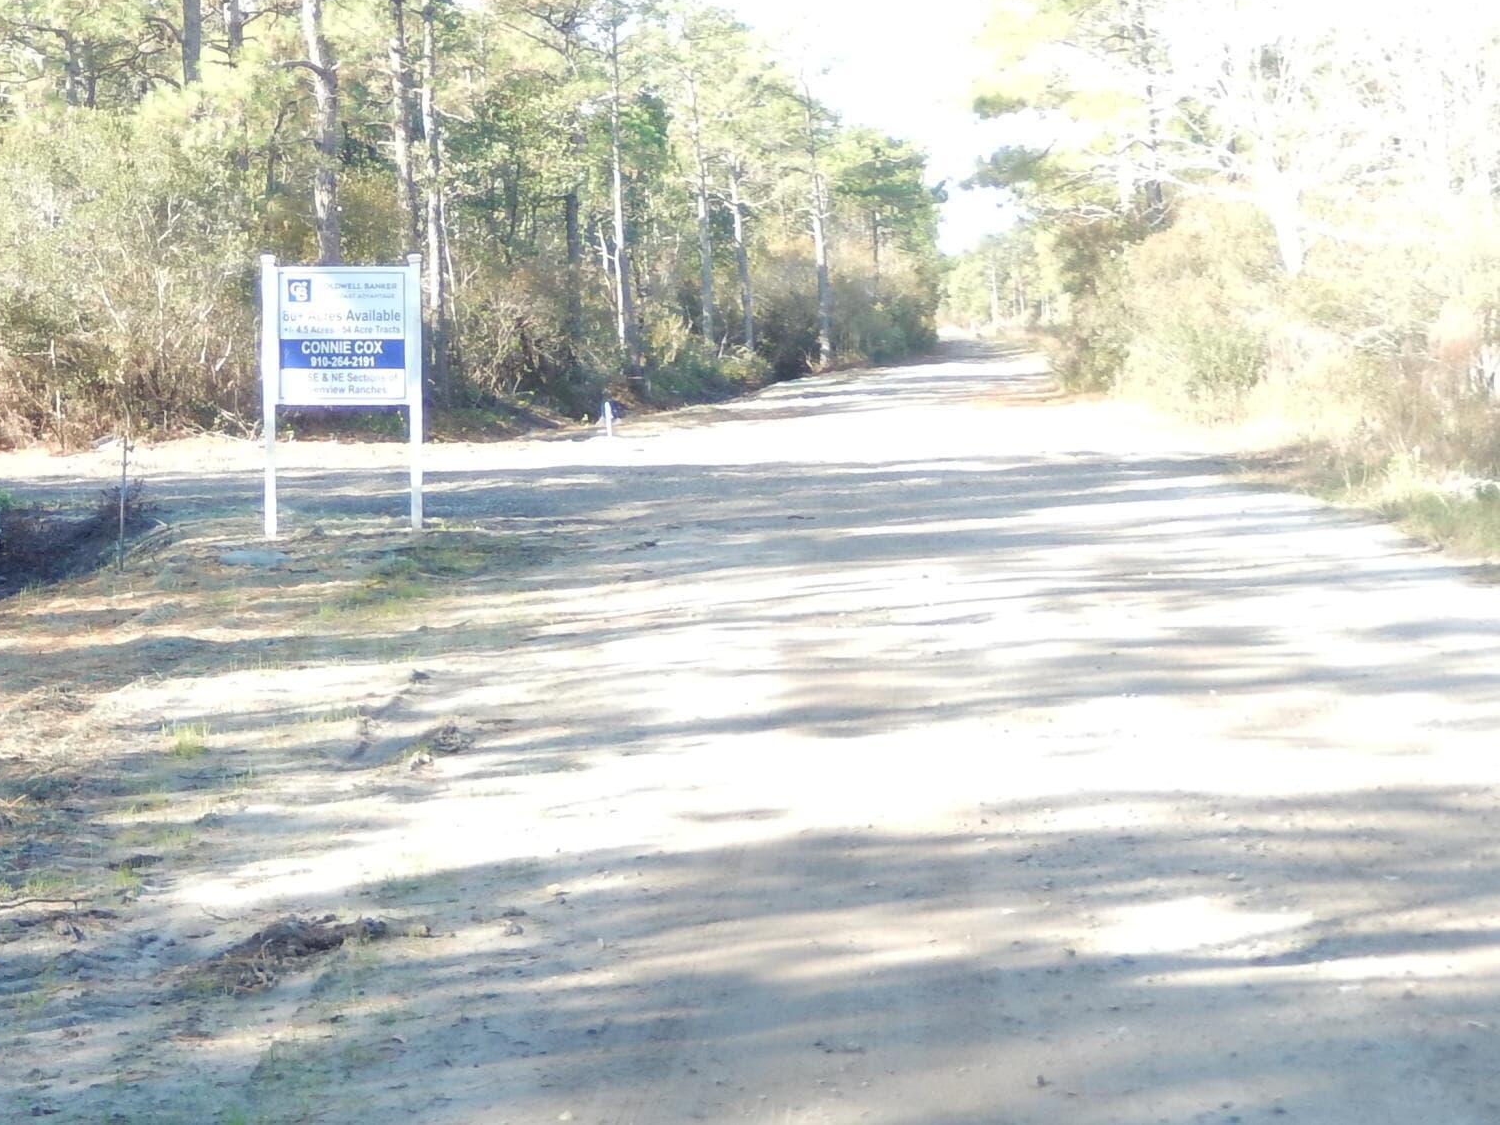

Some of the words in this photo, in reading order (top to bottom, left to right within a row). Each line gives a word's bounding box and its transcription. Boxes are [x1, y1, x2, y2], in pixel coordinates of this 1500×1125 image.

[323, 282, 362, 290] OLDWELL
[346, 309, 401, 322] Available
[354, 325, 373, 334] Acre
[375, 325, 401, 334] Tracts
[301, 341, 352, 354] CONNIE
[354, 341, 384, 354] COX
[310, 356, 375, 367] 910-264-2191
[322, 373, 329, 382] &
[331, 373, 345, 382] NE
[348, 385, 387, 394] Ranches
